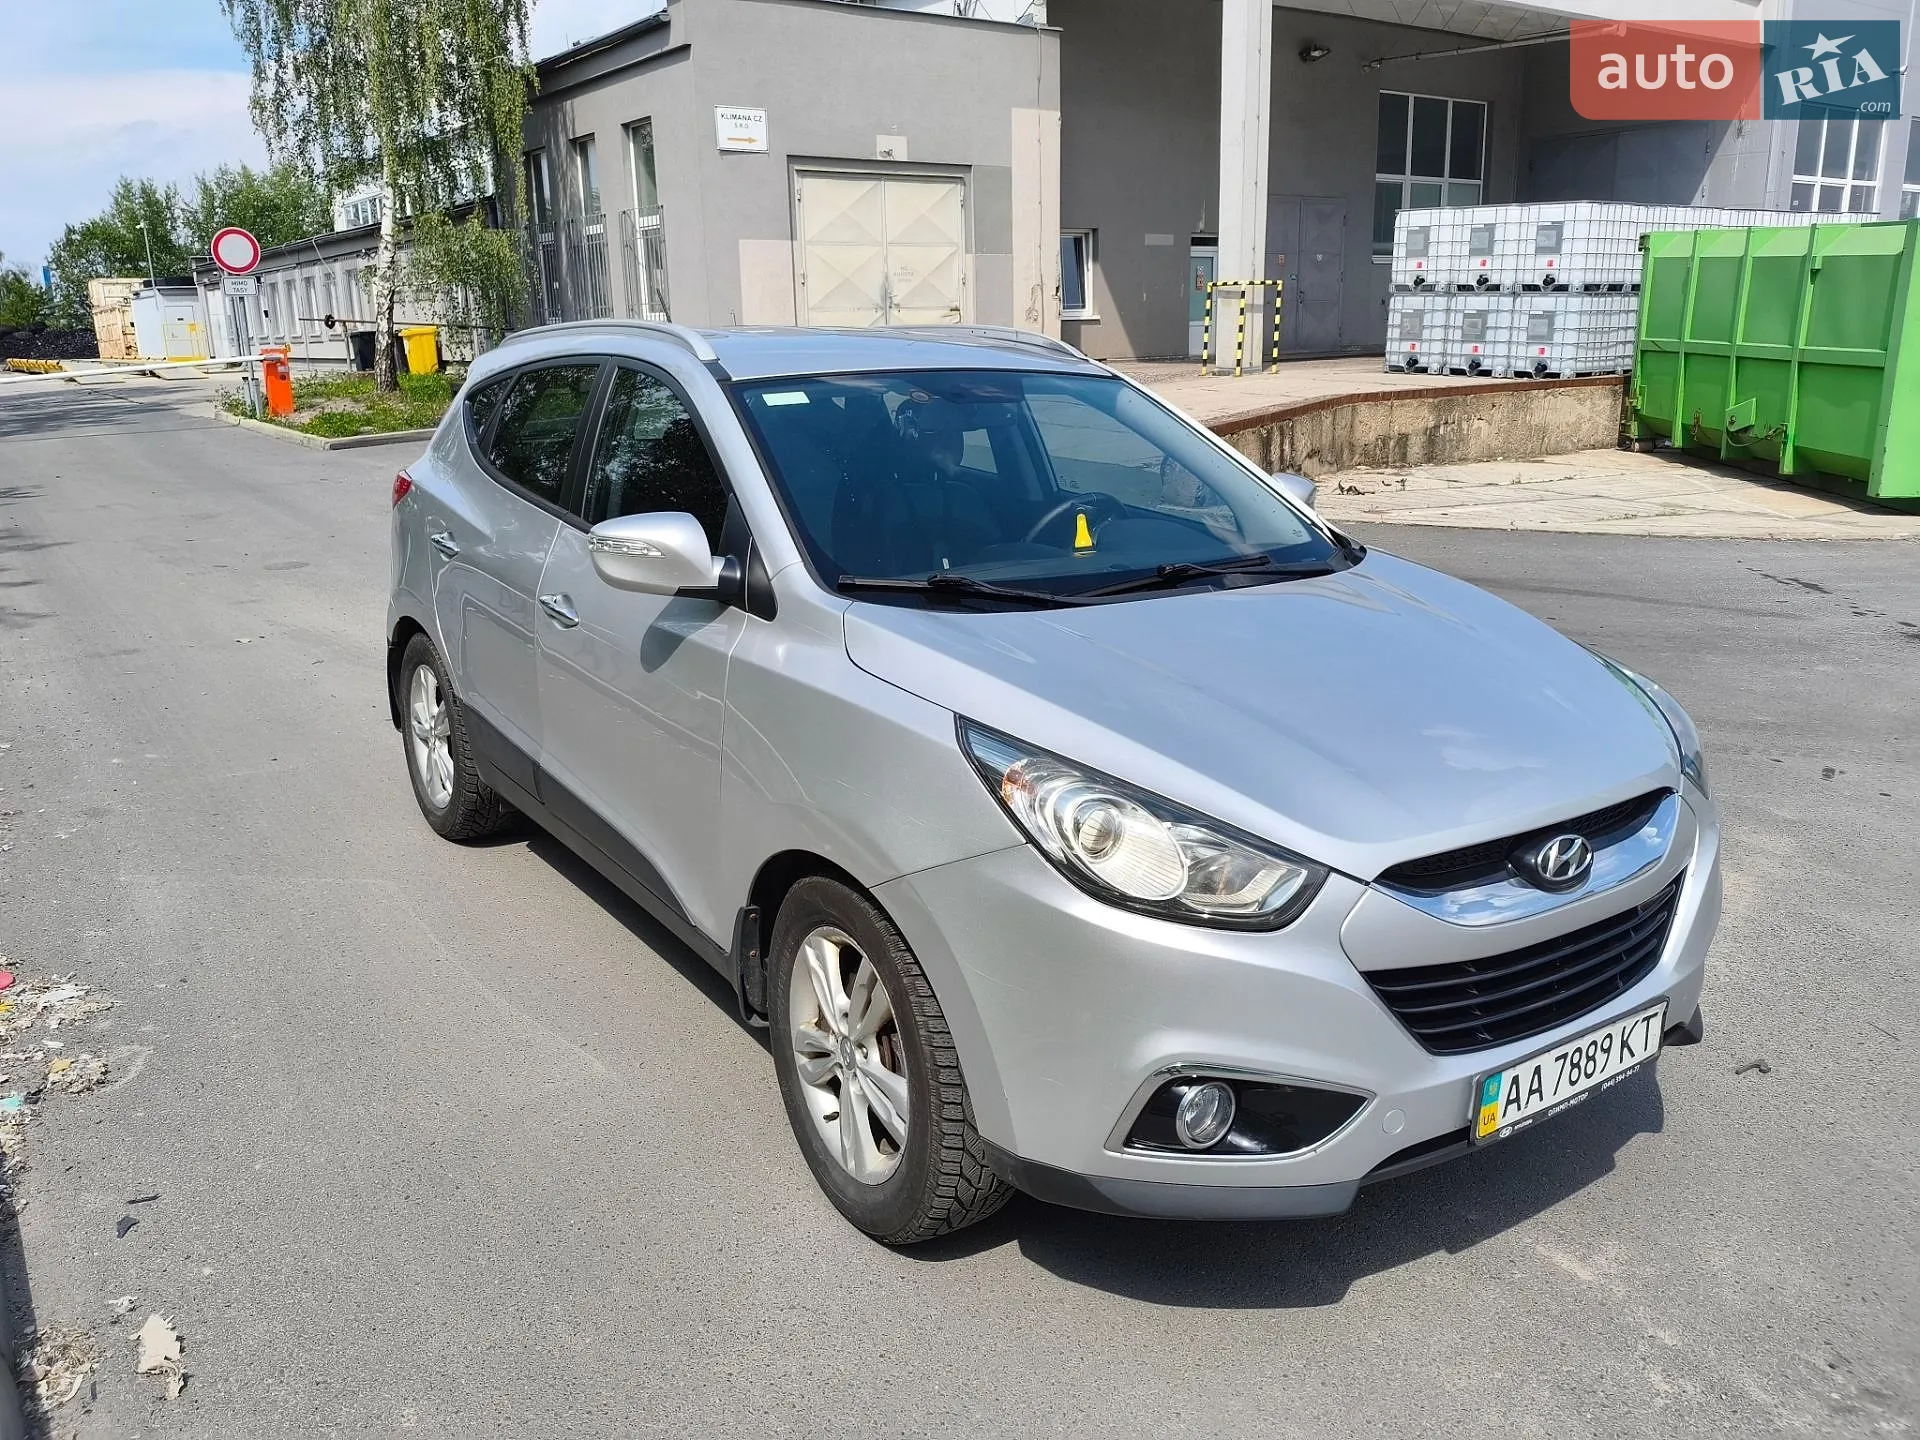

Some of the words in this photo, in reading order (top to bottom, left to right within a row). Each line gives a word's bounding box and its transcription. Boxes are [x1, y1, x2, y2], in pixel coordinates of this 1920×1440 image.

[720, 112, 752, 121] KLIMANA
[1483, 1112, 1496, 1126] UA
[1502, 1064, 1544, 1119] AA
[1552, 1033, 1613, 1096] 7889
[1619, 1012, 1659, 1065] KT
